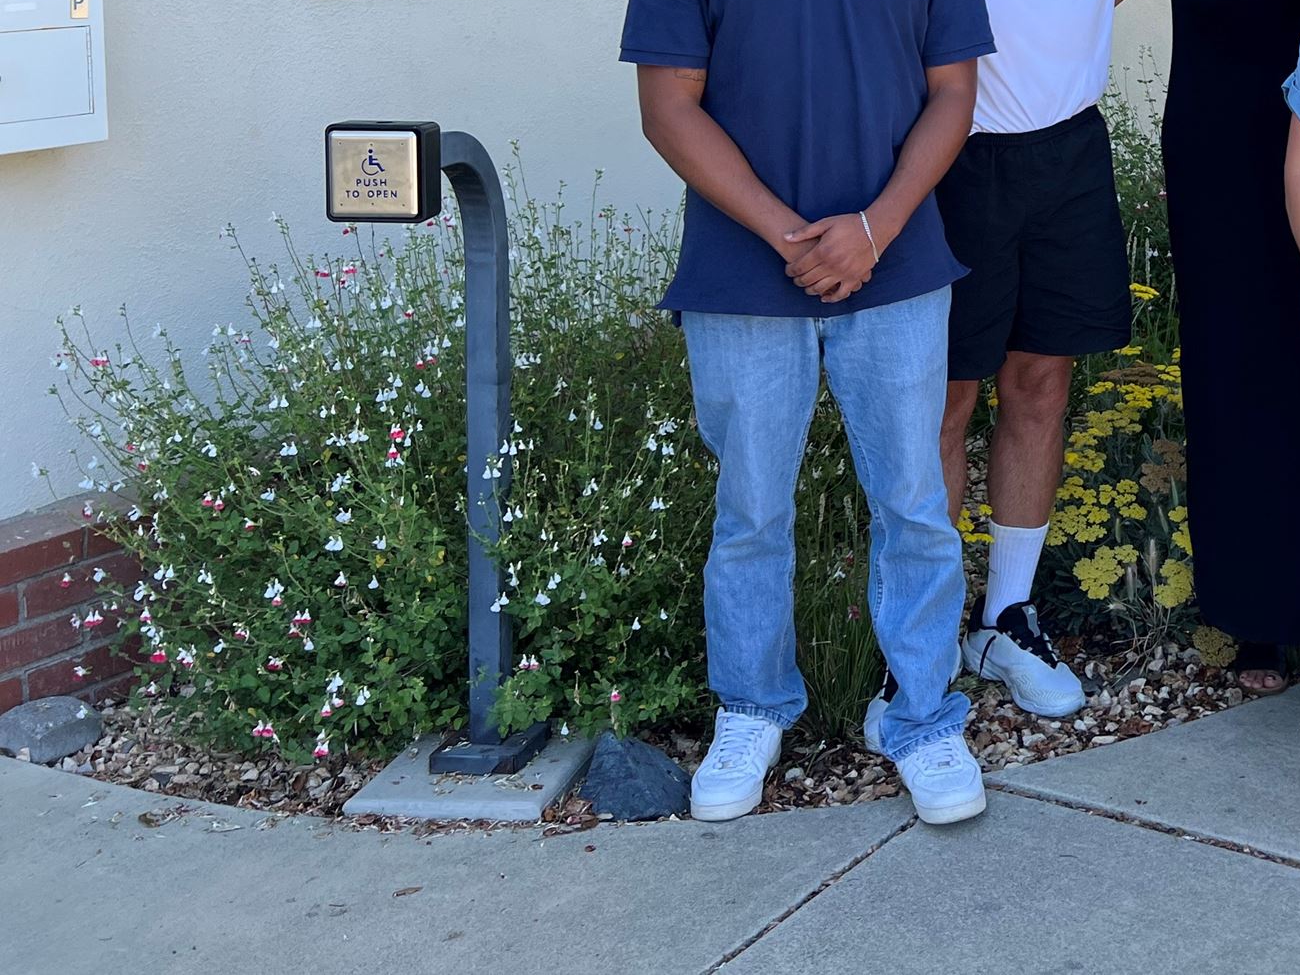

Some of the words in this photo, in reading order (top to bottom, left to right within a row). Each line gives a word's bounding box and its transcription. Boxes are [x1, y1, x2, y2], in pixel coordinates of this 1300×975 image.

[355, 178, 387, 187] PUSH
[345, 190, 360, 198] TO
[367, 190, 398, 198] OPEN
